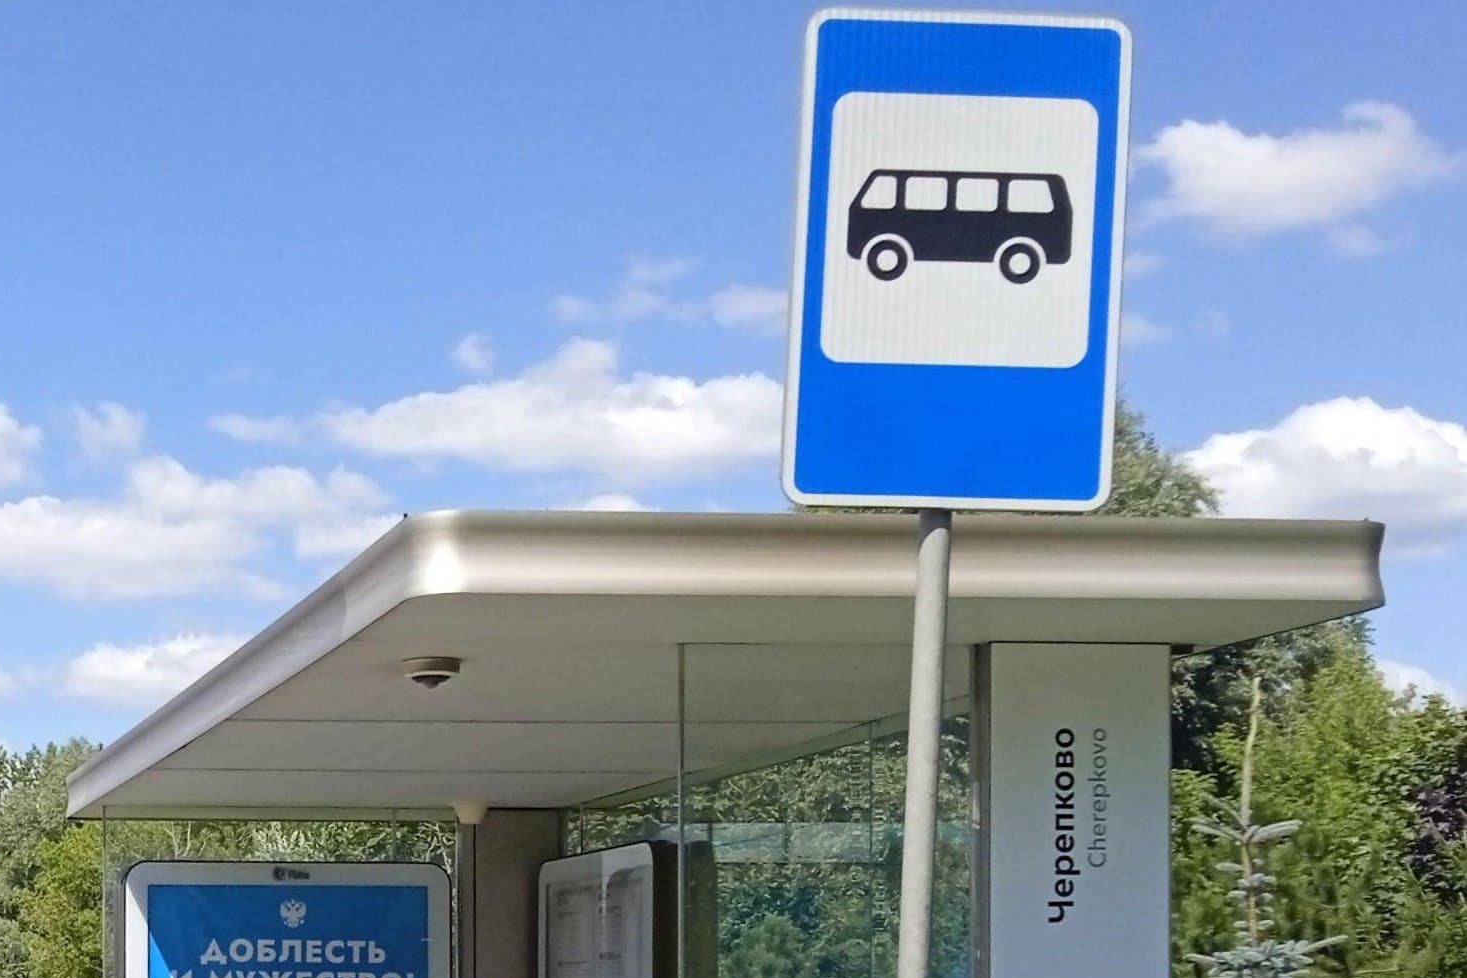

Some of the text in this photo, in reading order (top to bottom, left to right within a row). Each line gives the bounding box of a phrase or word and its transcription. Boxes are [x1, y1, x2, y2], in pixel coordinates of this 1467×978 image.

[1047, 727, 1081, 924] Черепково
[1087, 727, 1111, 868] Cherepkovo
[200, 938, 386, 965] ДОБЛЕСТЬ
